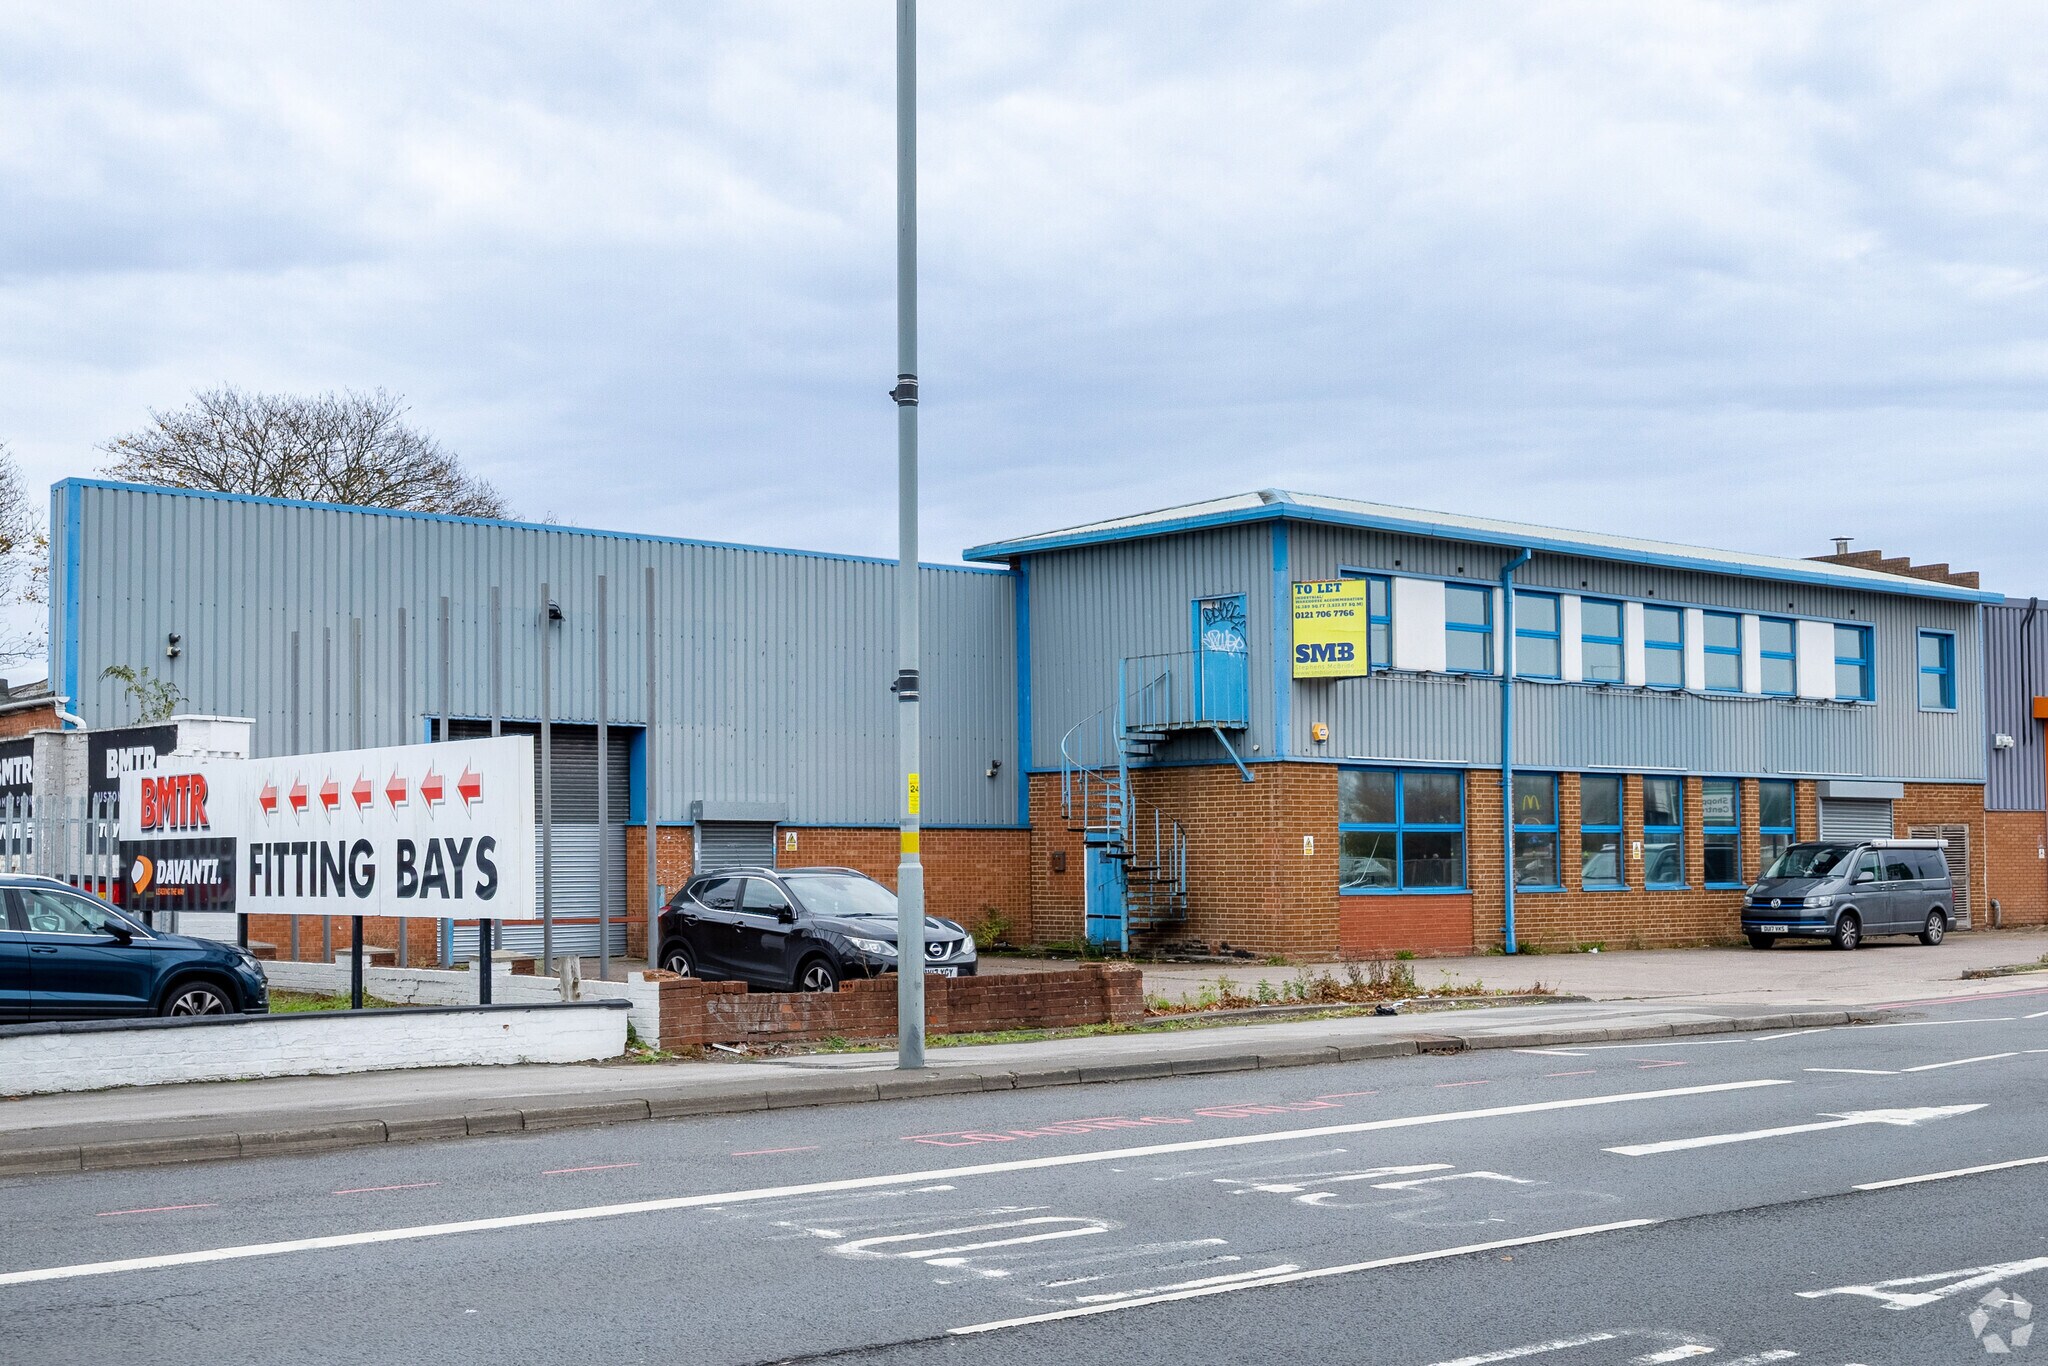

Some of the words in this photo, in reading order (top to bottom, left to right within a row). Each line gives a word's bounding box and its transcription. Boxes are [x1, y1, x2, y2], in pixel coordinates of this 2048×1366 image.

[1295, 584, 1312, 594] TO
[1317, 583, 1342, 593] LET
[1295, 611, 1314, 619] 0121
[1315, 610, 1332, 618] 706
[1333, 609, 1355, 617] 7766
[1296, 643, 1354, 663] SMB
[106, 746, 157, 779] BMTR
[141, 773, 210, 832] BMTR
[250, 838, 376, 899] FITTING
[397, 835, 498, 900] BAYS
